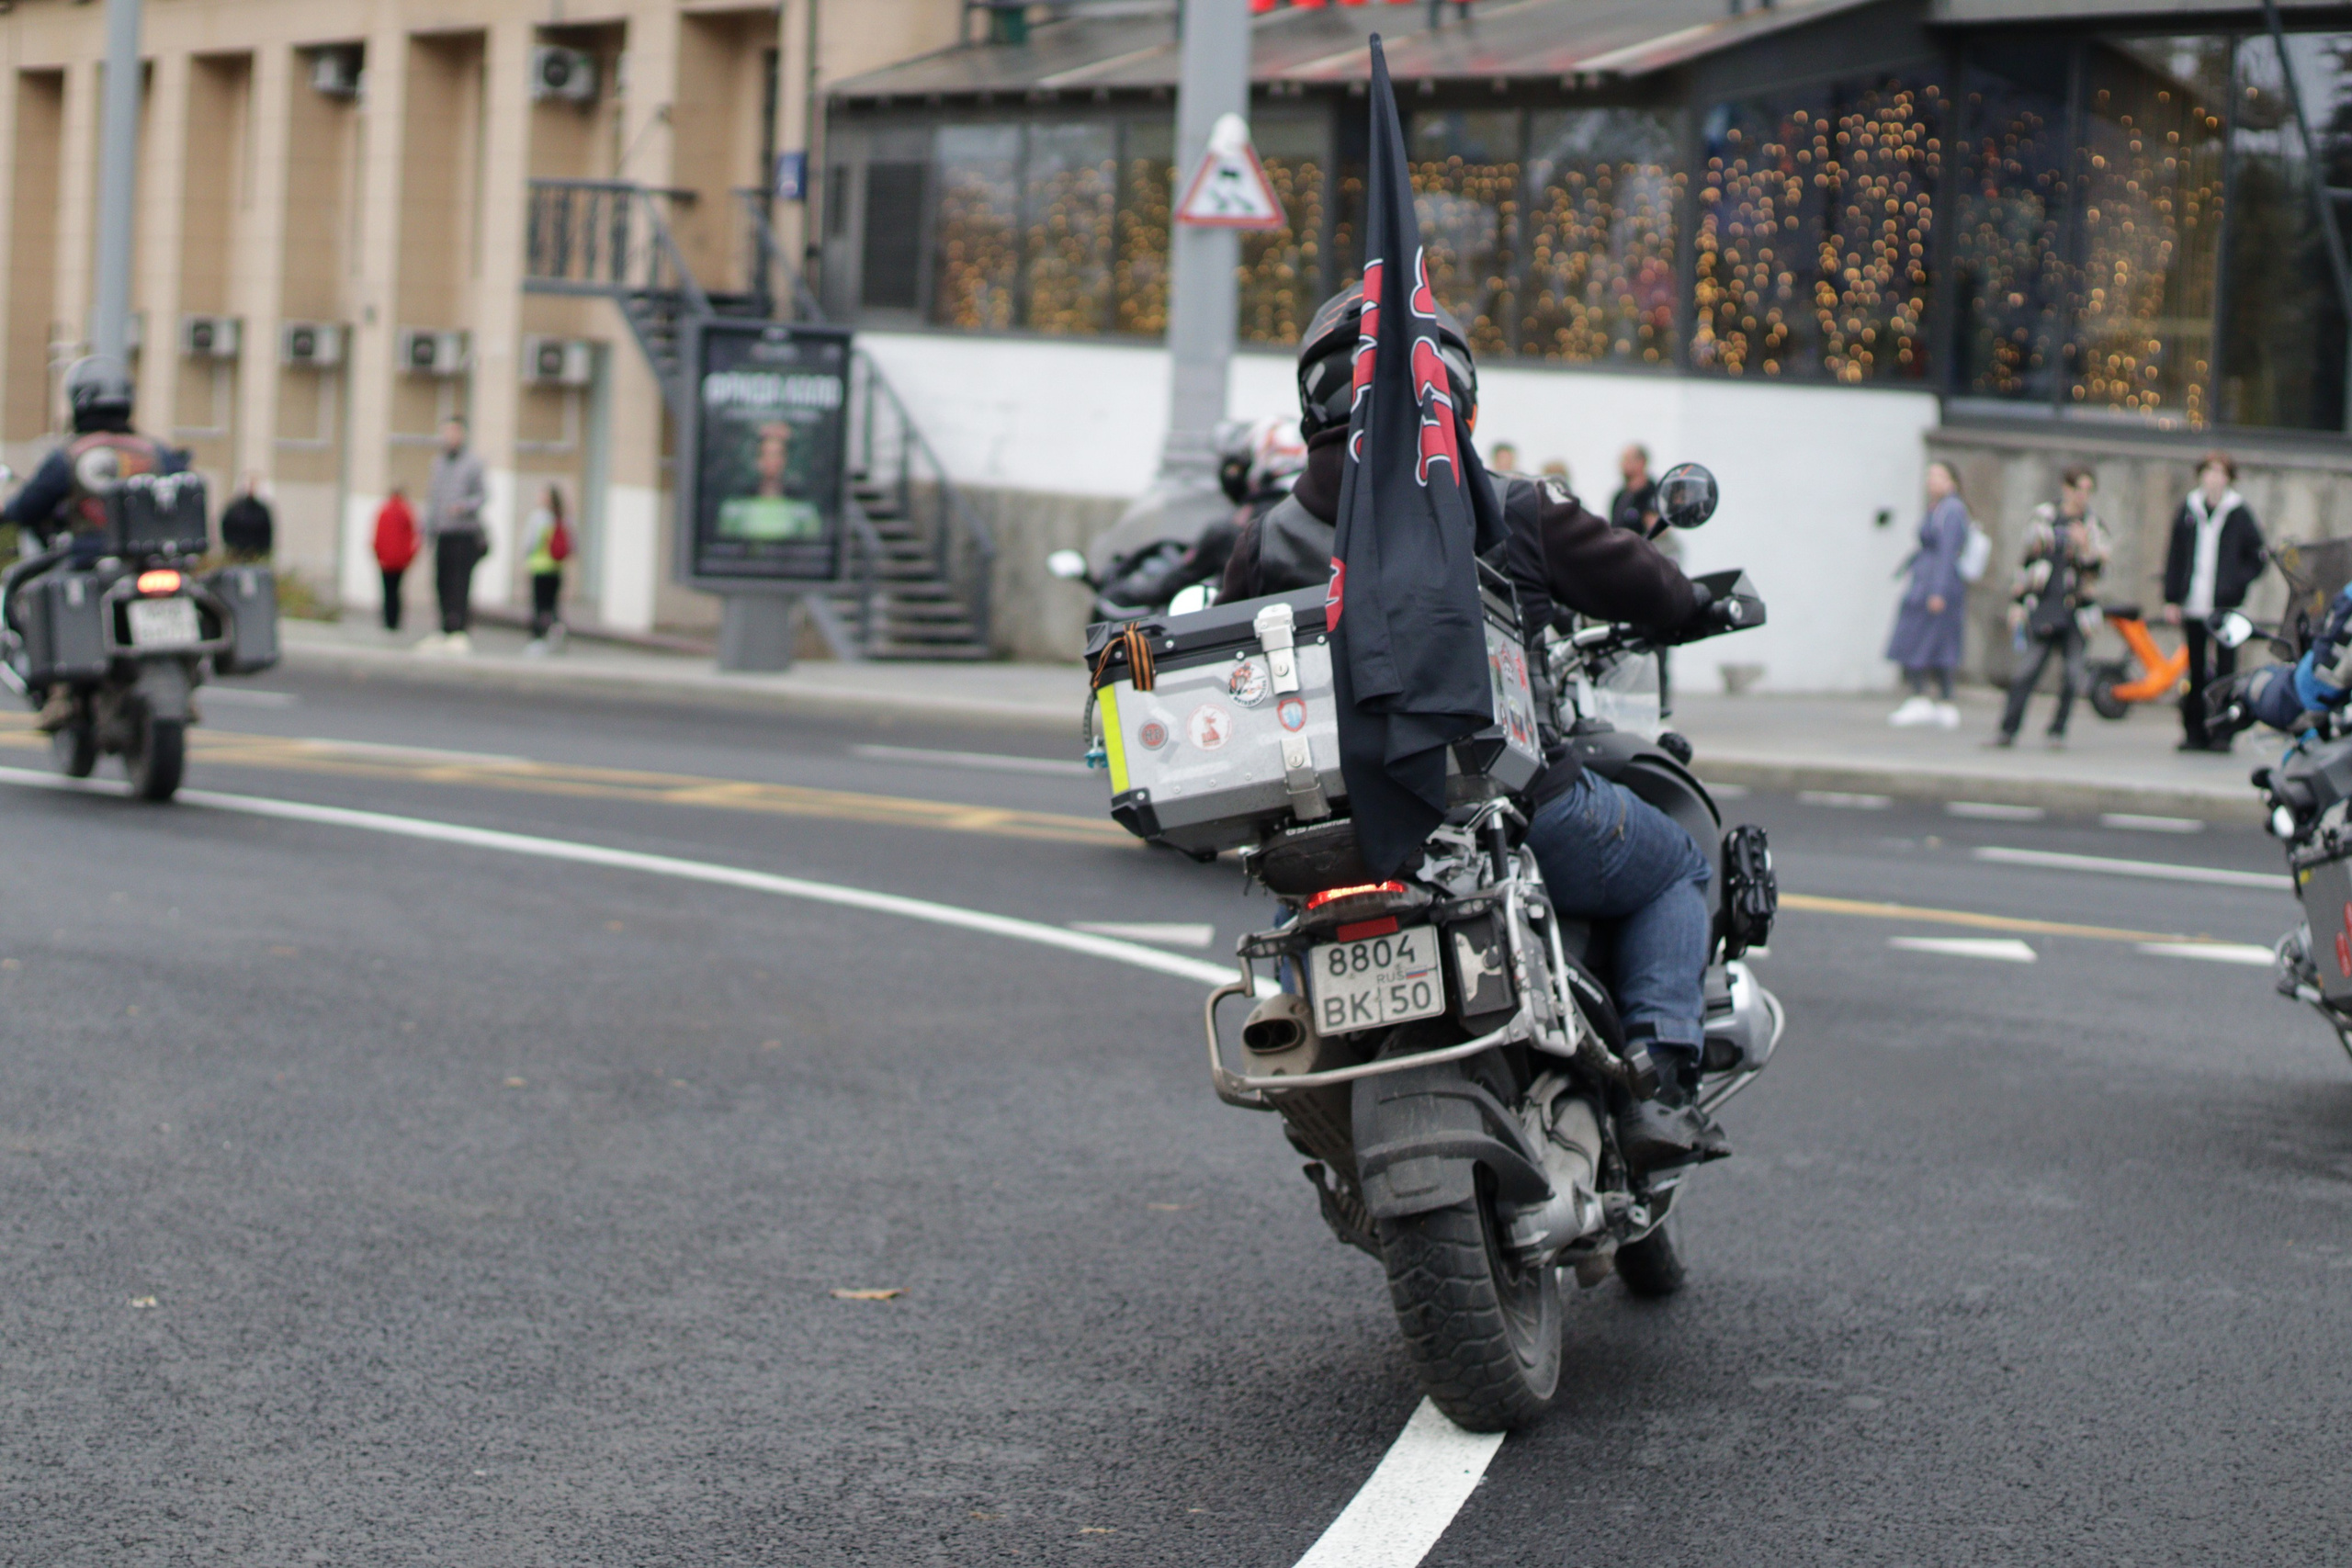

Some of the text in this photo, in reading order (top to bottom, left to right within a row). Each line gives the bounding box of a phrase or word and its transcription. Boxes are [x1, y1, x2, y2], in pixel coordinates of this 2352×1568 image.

[1328, 934, 1416, 977] 8804
[1376, 970, 1407, 984] RUS
[1390, 981, 1431, 1014] 50
